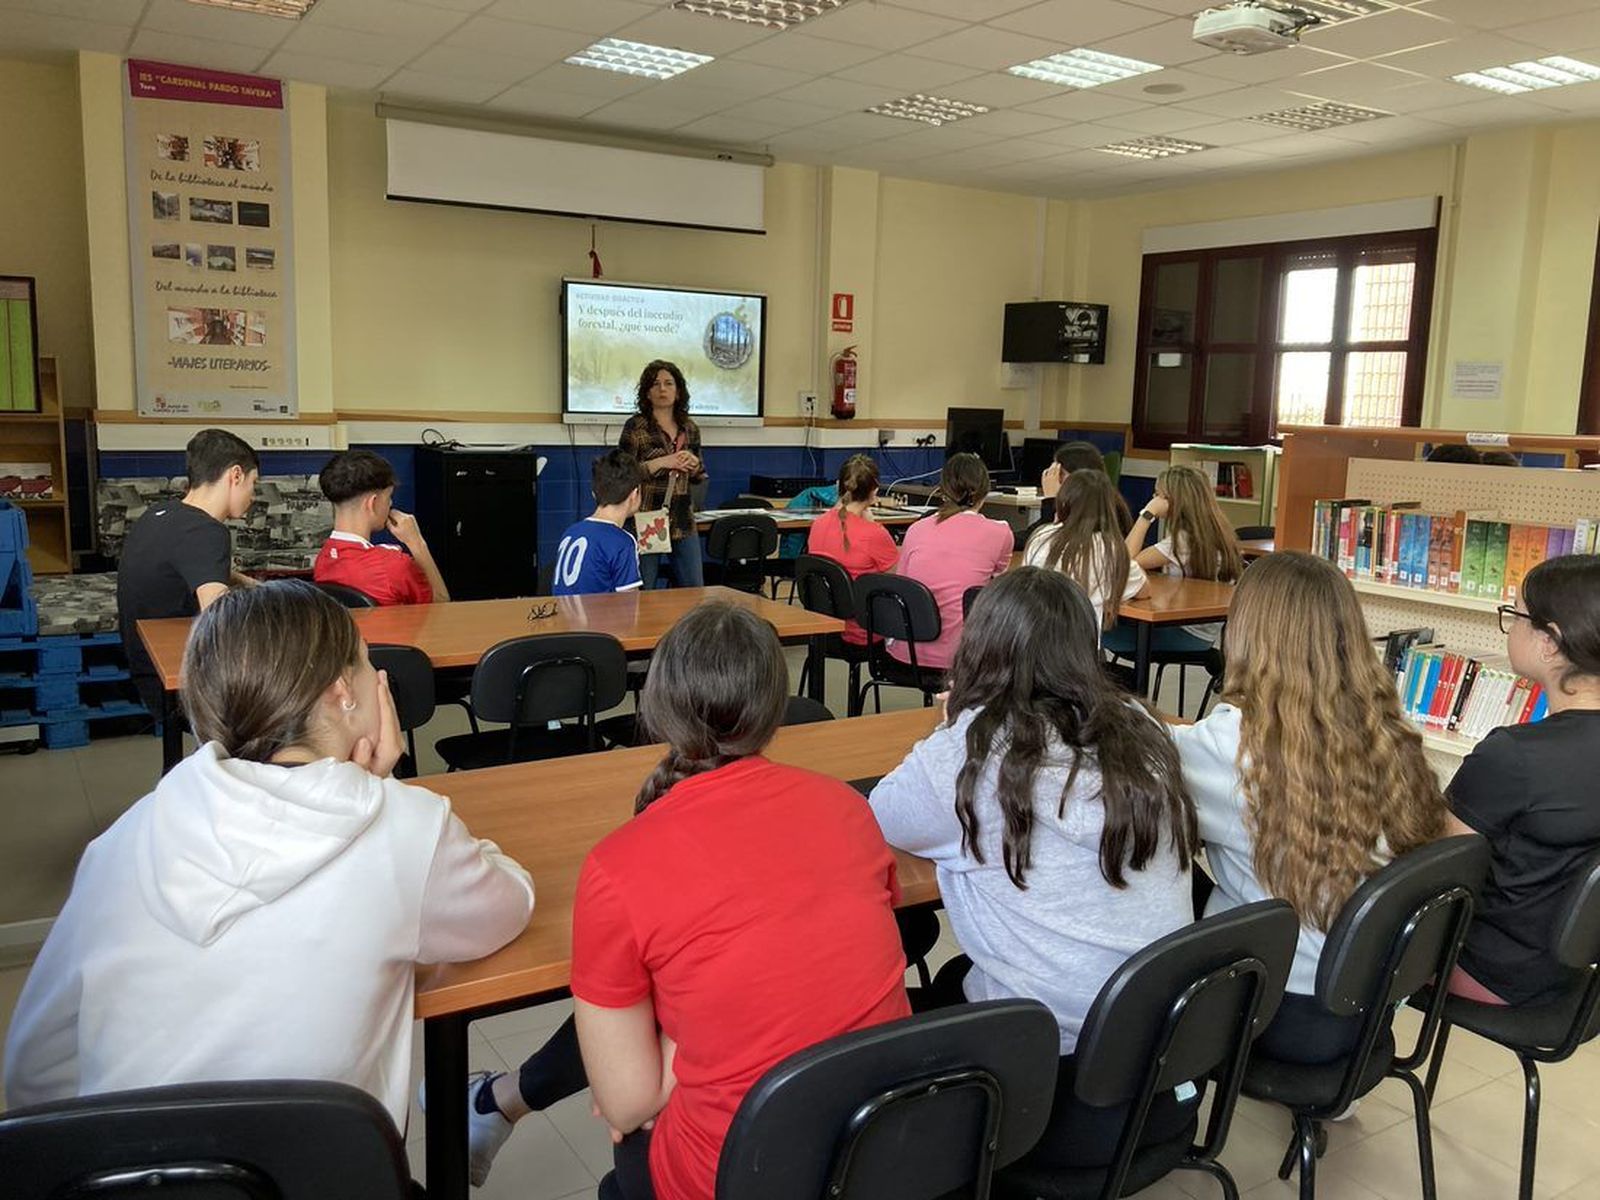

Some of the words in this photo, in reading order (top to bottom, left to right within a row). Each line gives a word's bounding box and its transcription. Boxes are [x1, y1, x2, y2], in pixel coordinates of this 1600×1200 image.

[139, 72, 153, 82] IES
[208, 82, 239, 94] PARDO
[139, 82, 156, 91] Toro
[150, 169, 162, 181] De
[165, 171, 176, 181] la
[178, 172, 226, 187] biblioteca
[241, 181, 274, 192] mundo
[155, 280, 173, 292] Del
[174, 284, 209, 294] mundo
[220, 284, 231, 295] la
[232, 286, 278, 298] biblioteca
[578, 303, 584, 314] Y
[587, 305, 626, 318] después
[627, 306, 642, 318] del
[643, 307, 683, 321] incendio
[578, 317, 618, 331] forestal,
[619, 320, 642, 332] ¿qué
[644, 322, 681, 334] sucede?
[554, 535, 589, 587] 10
